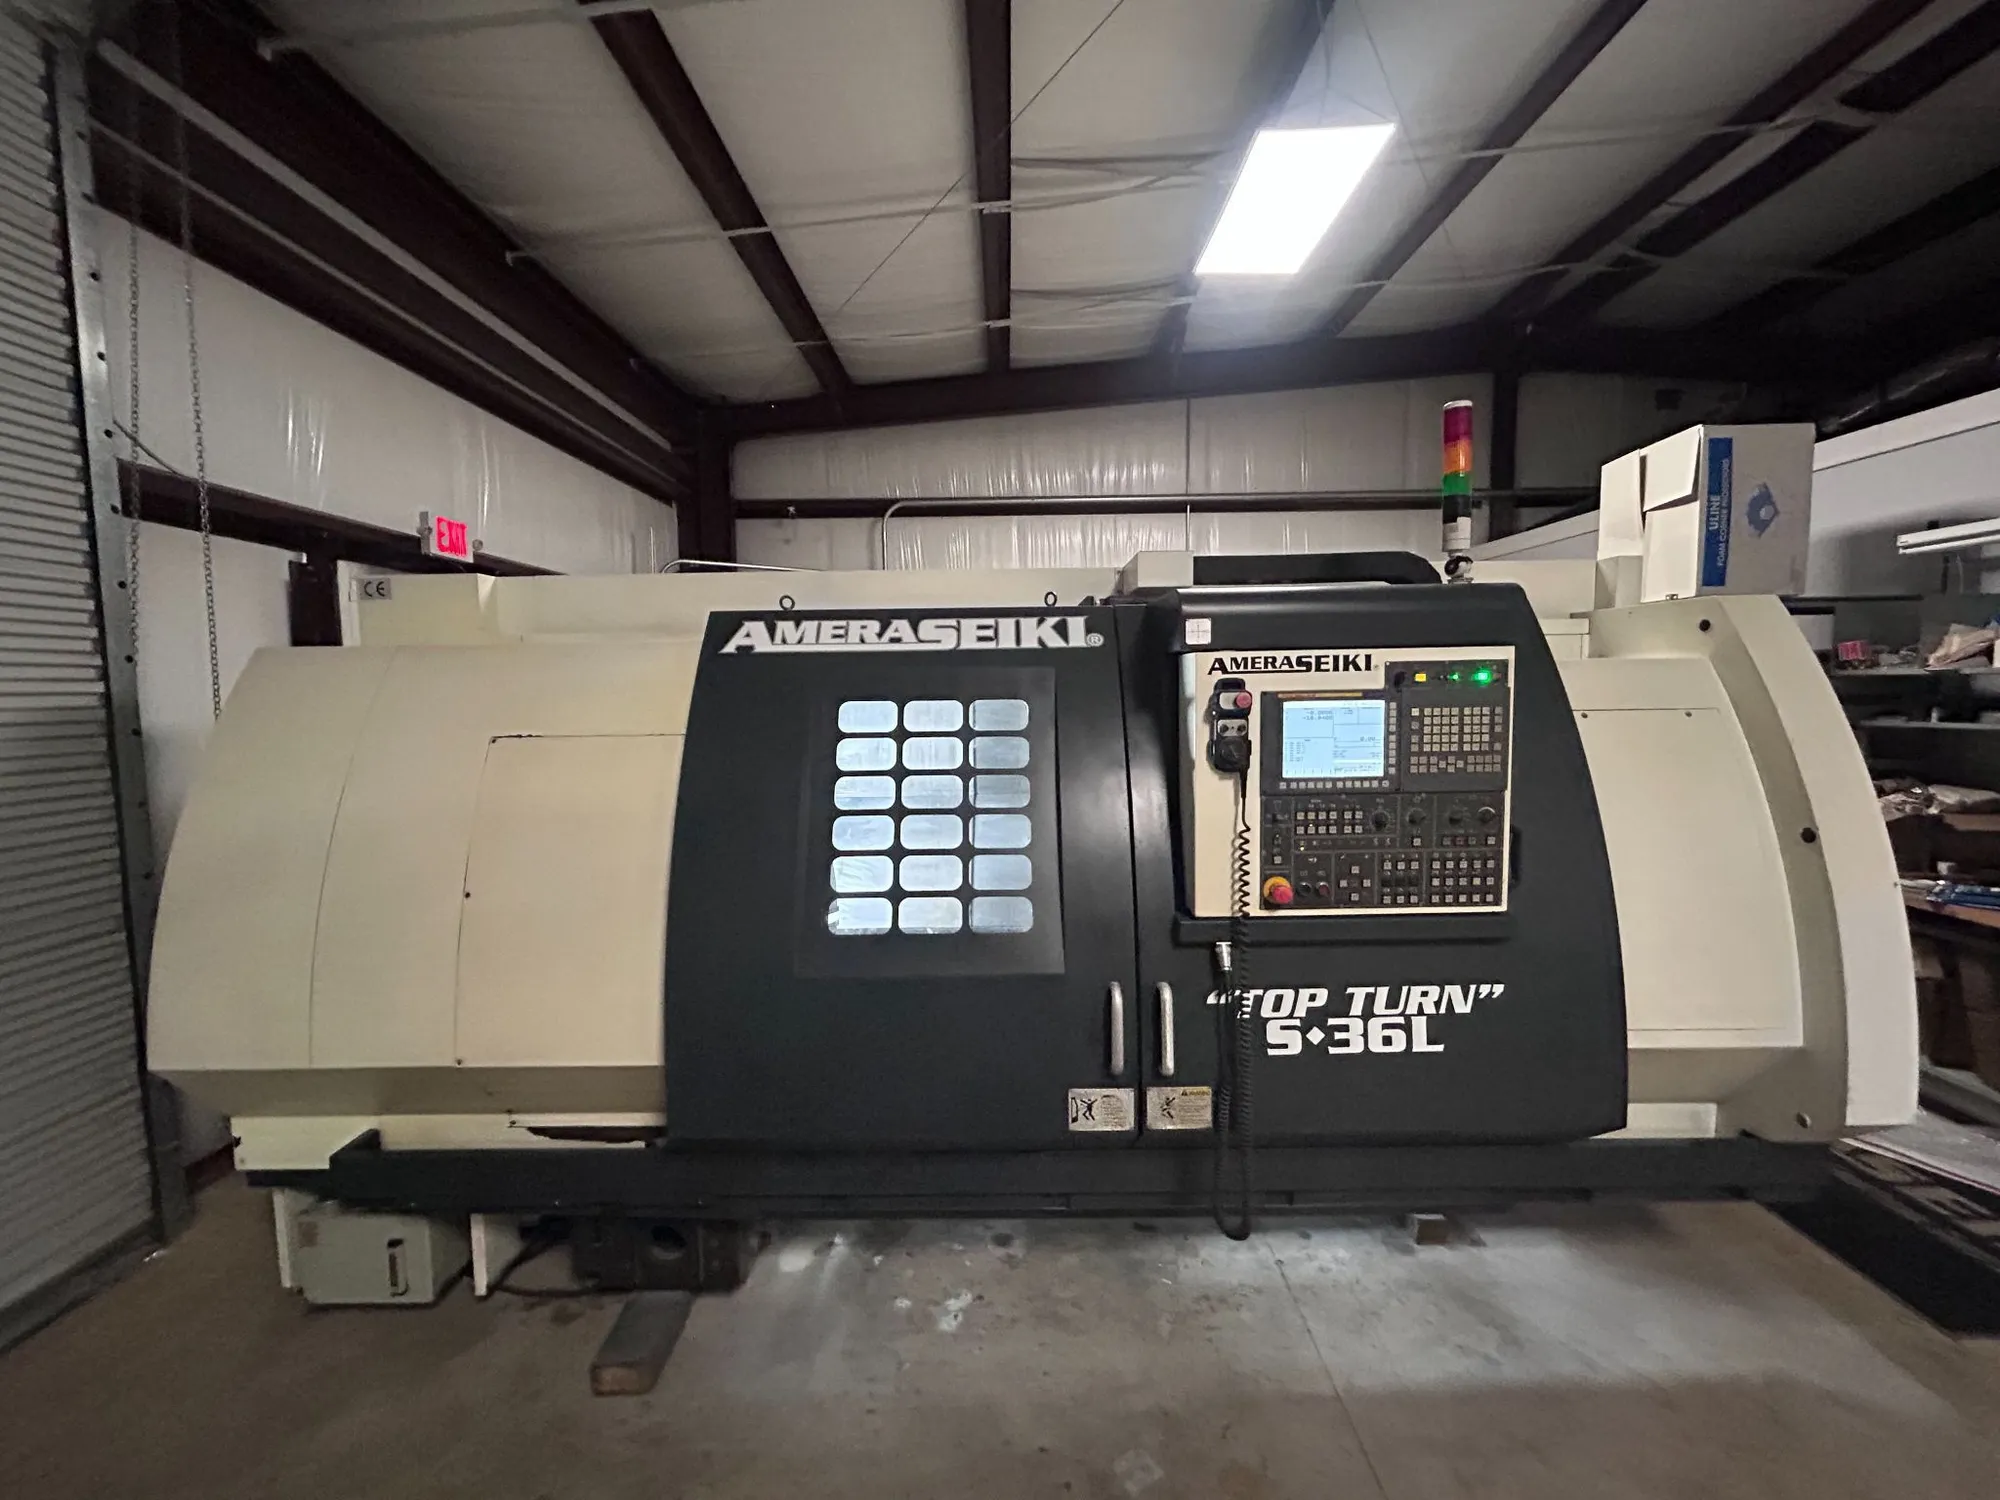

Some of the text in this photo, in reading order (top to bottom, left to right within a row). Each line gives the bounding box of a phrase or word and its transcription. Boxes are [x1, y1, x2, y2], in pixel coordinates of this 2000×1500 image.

[1709, 494, 1720, 531] ULINE
[436, 516, 468, 557] EXIT
[364, 581, 385, 597] CE
[1208, 654, 1372, 675] AMERASEIKI
